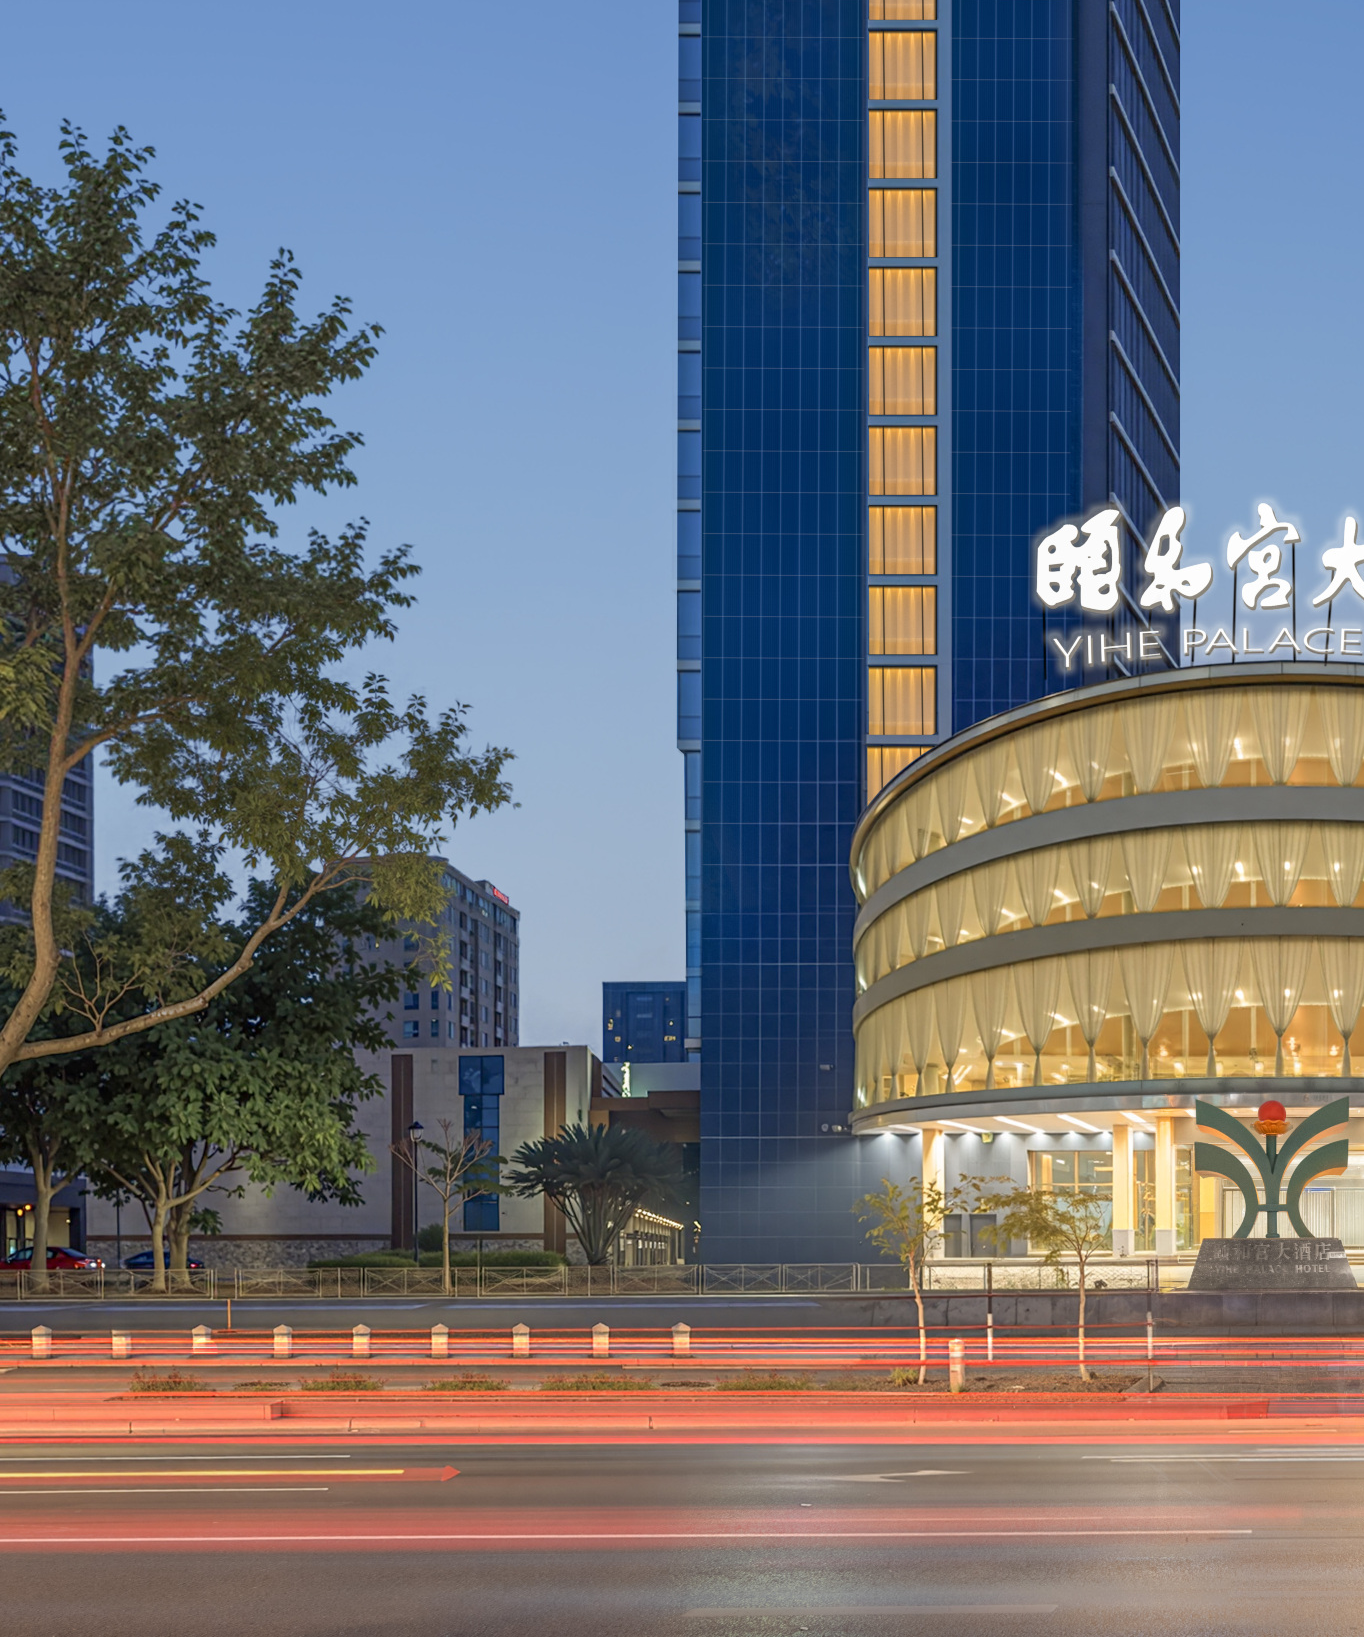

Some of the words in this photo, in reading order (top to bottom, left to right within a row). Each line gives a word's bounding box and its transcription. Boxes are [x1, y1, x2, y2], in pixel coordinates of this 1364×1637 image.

[1053, 629, 1162, 668] YIHE
[1183, 628, 1363, 656] PALACE
[1295, 1264, 1331, 1273] HOTEL
